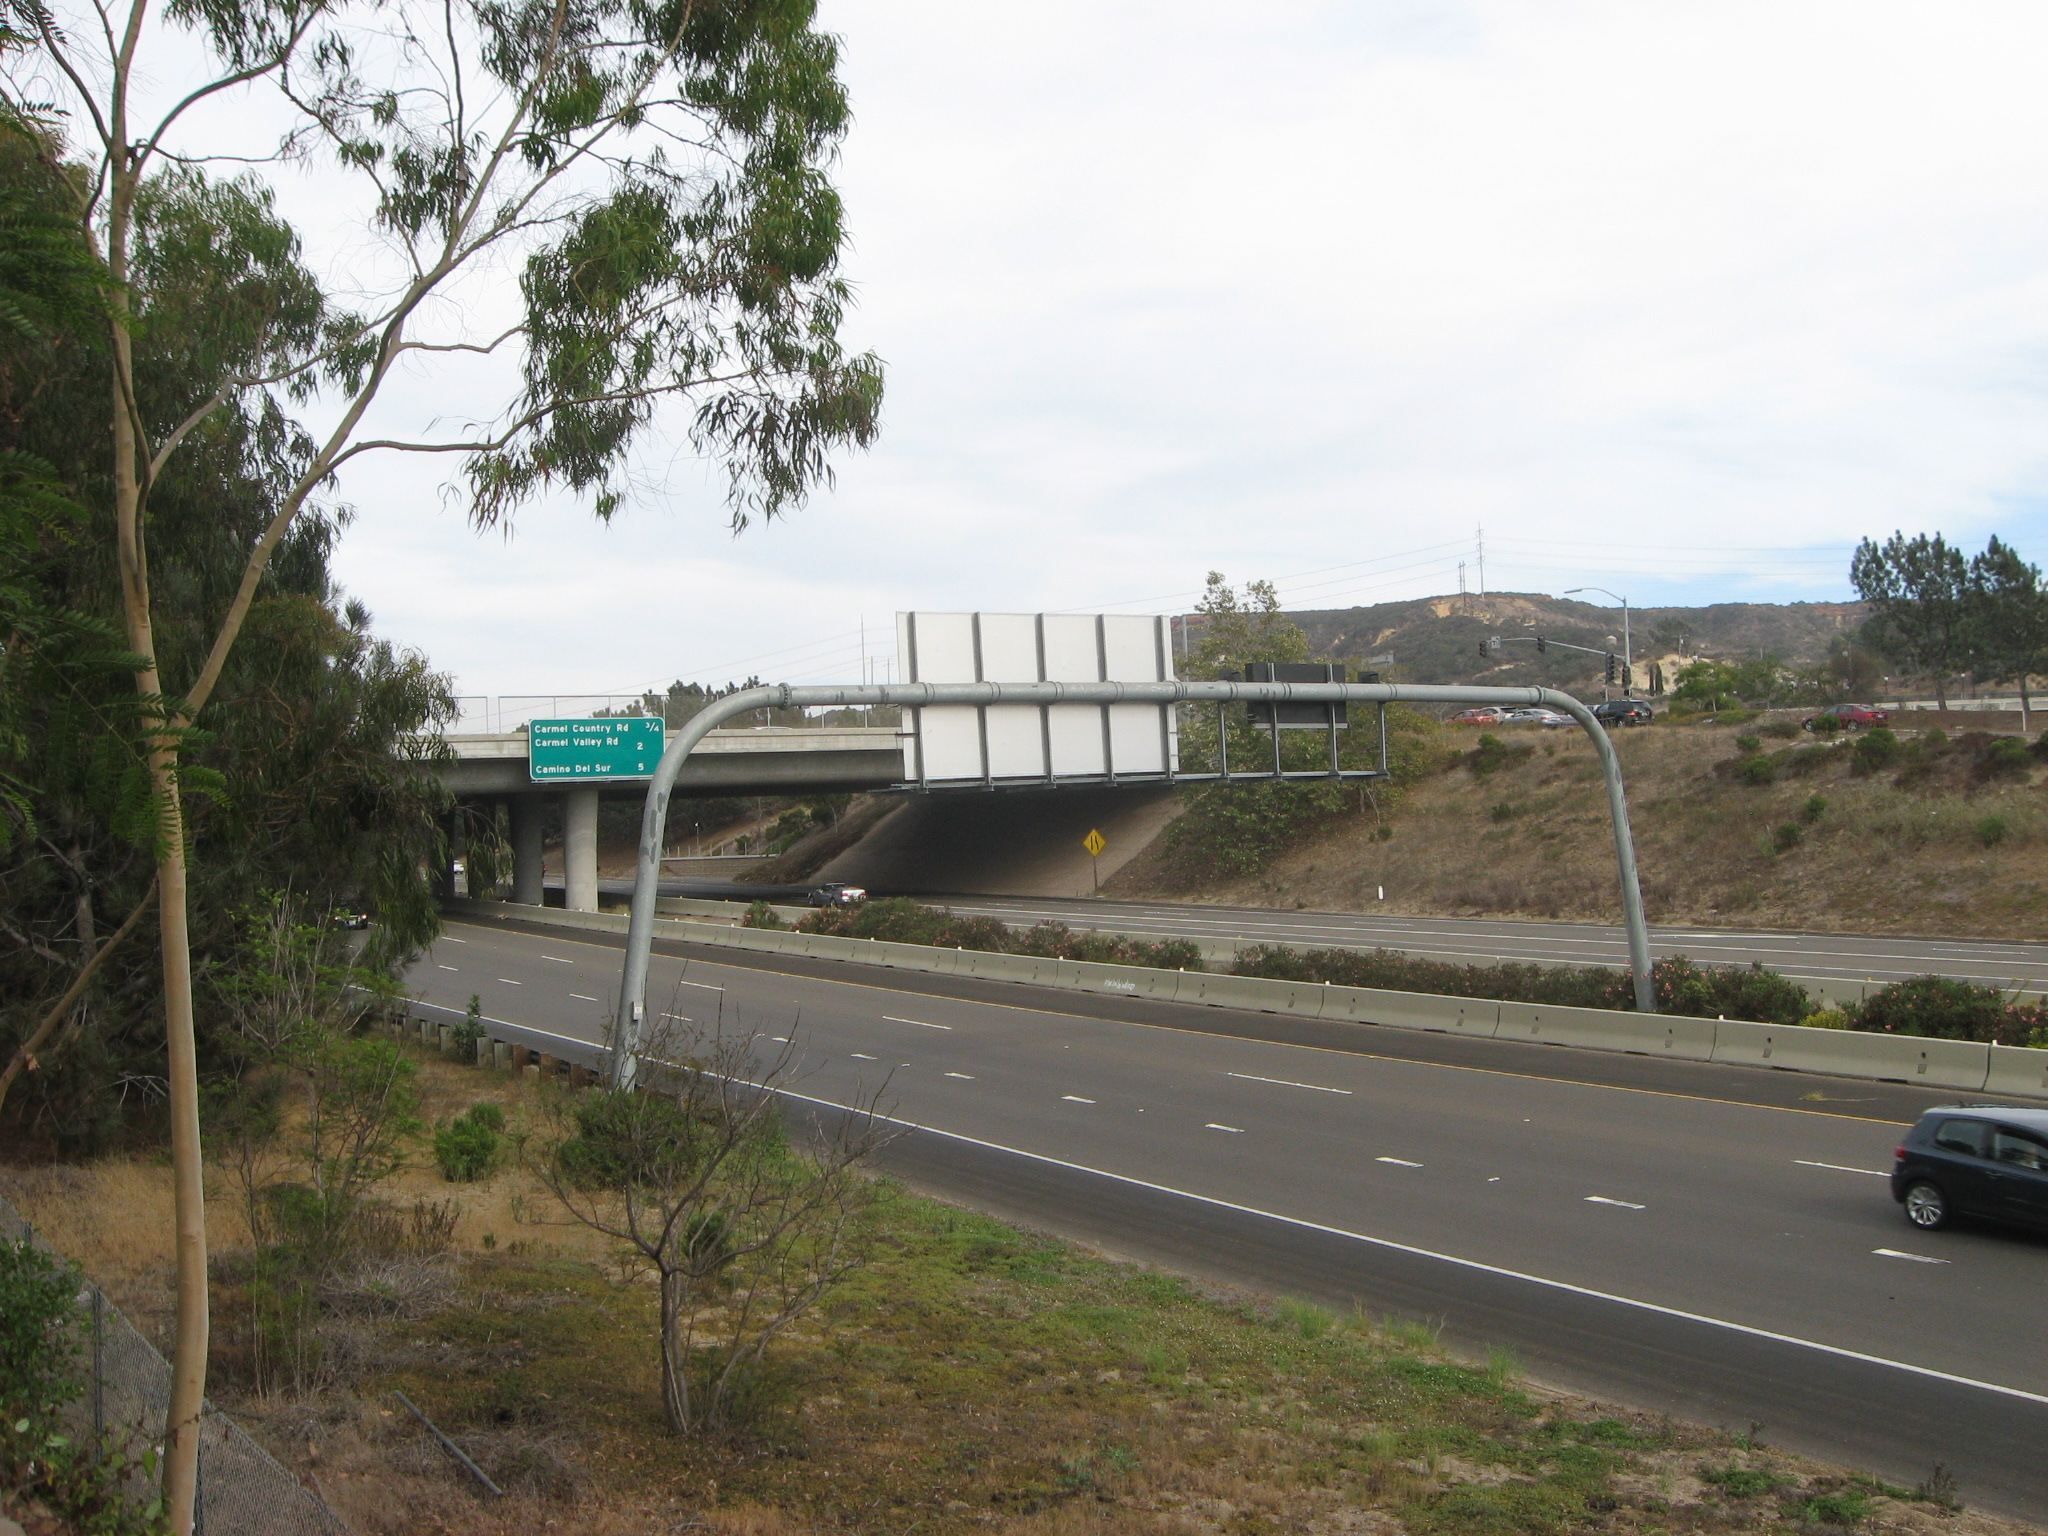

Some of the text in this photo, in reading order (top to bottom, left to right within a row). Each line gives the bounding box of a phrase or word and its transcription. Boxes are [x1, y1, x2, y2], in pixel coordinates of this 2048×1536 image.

[535, 724, 567, 733] Carmel
[573, 724, 611, 733] Country
[617, 724, 629, 732] Rd
[535, 737, 643, 750] Carmel Valley Rd 2
[536, 763, 644, 773] Camino Del Sur 5
